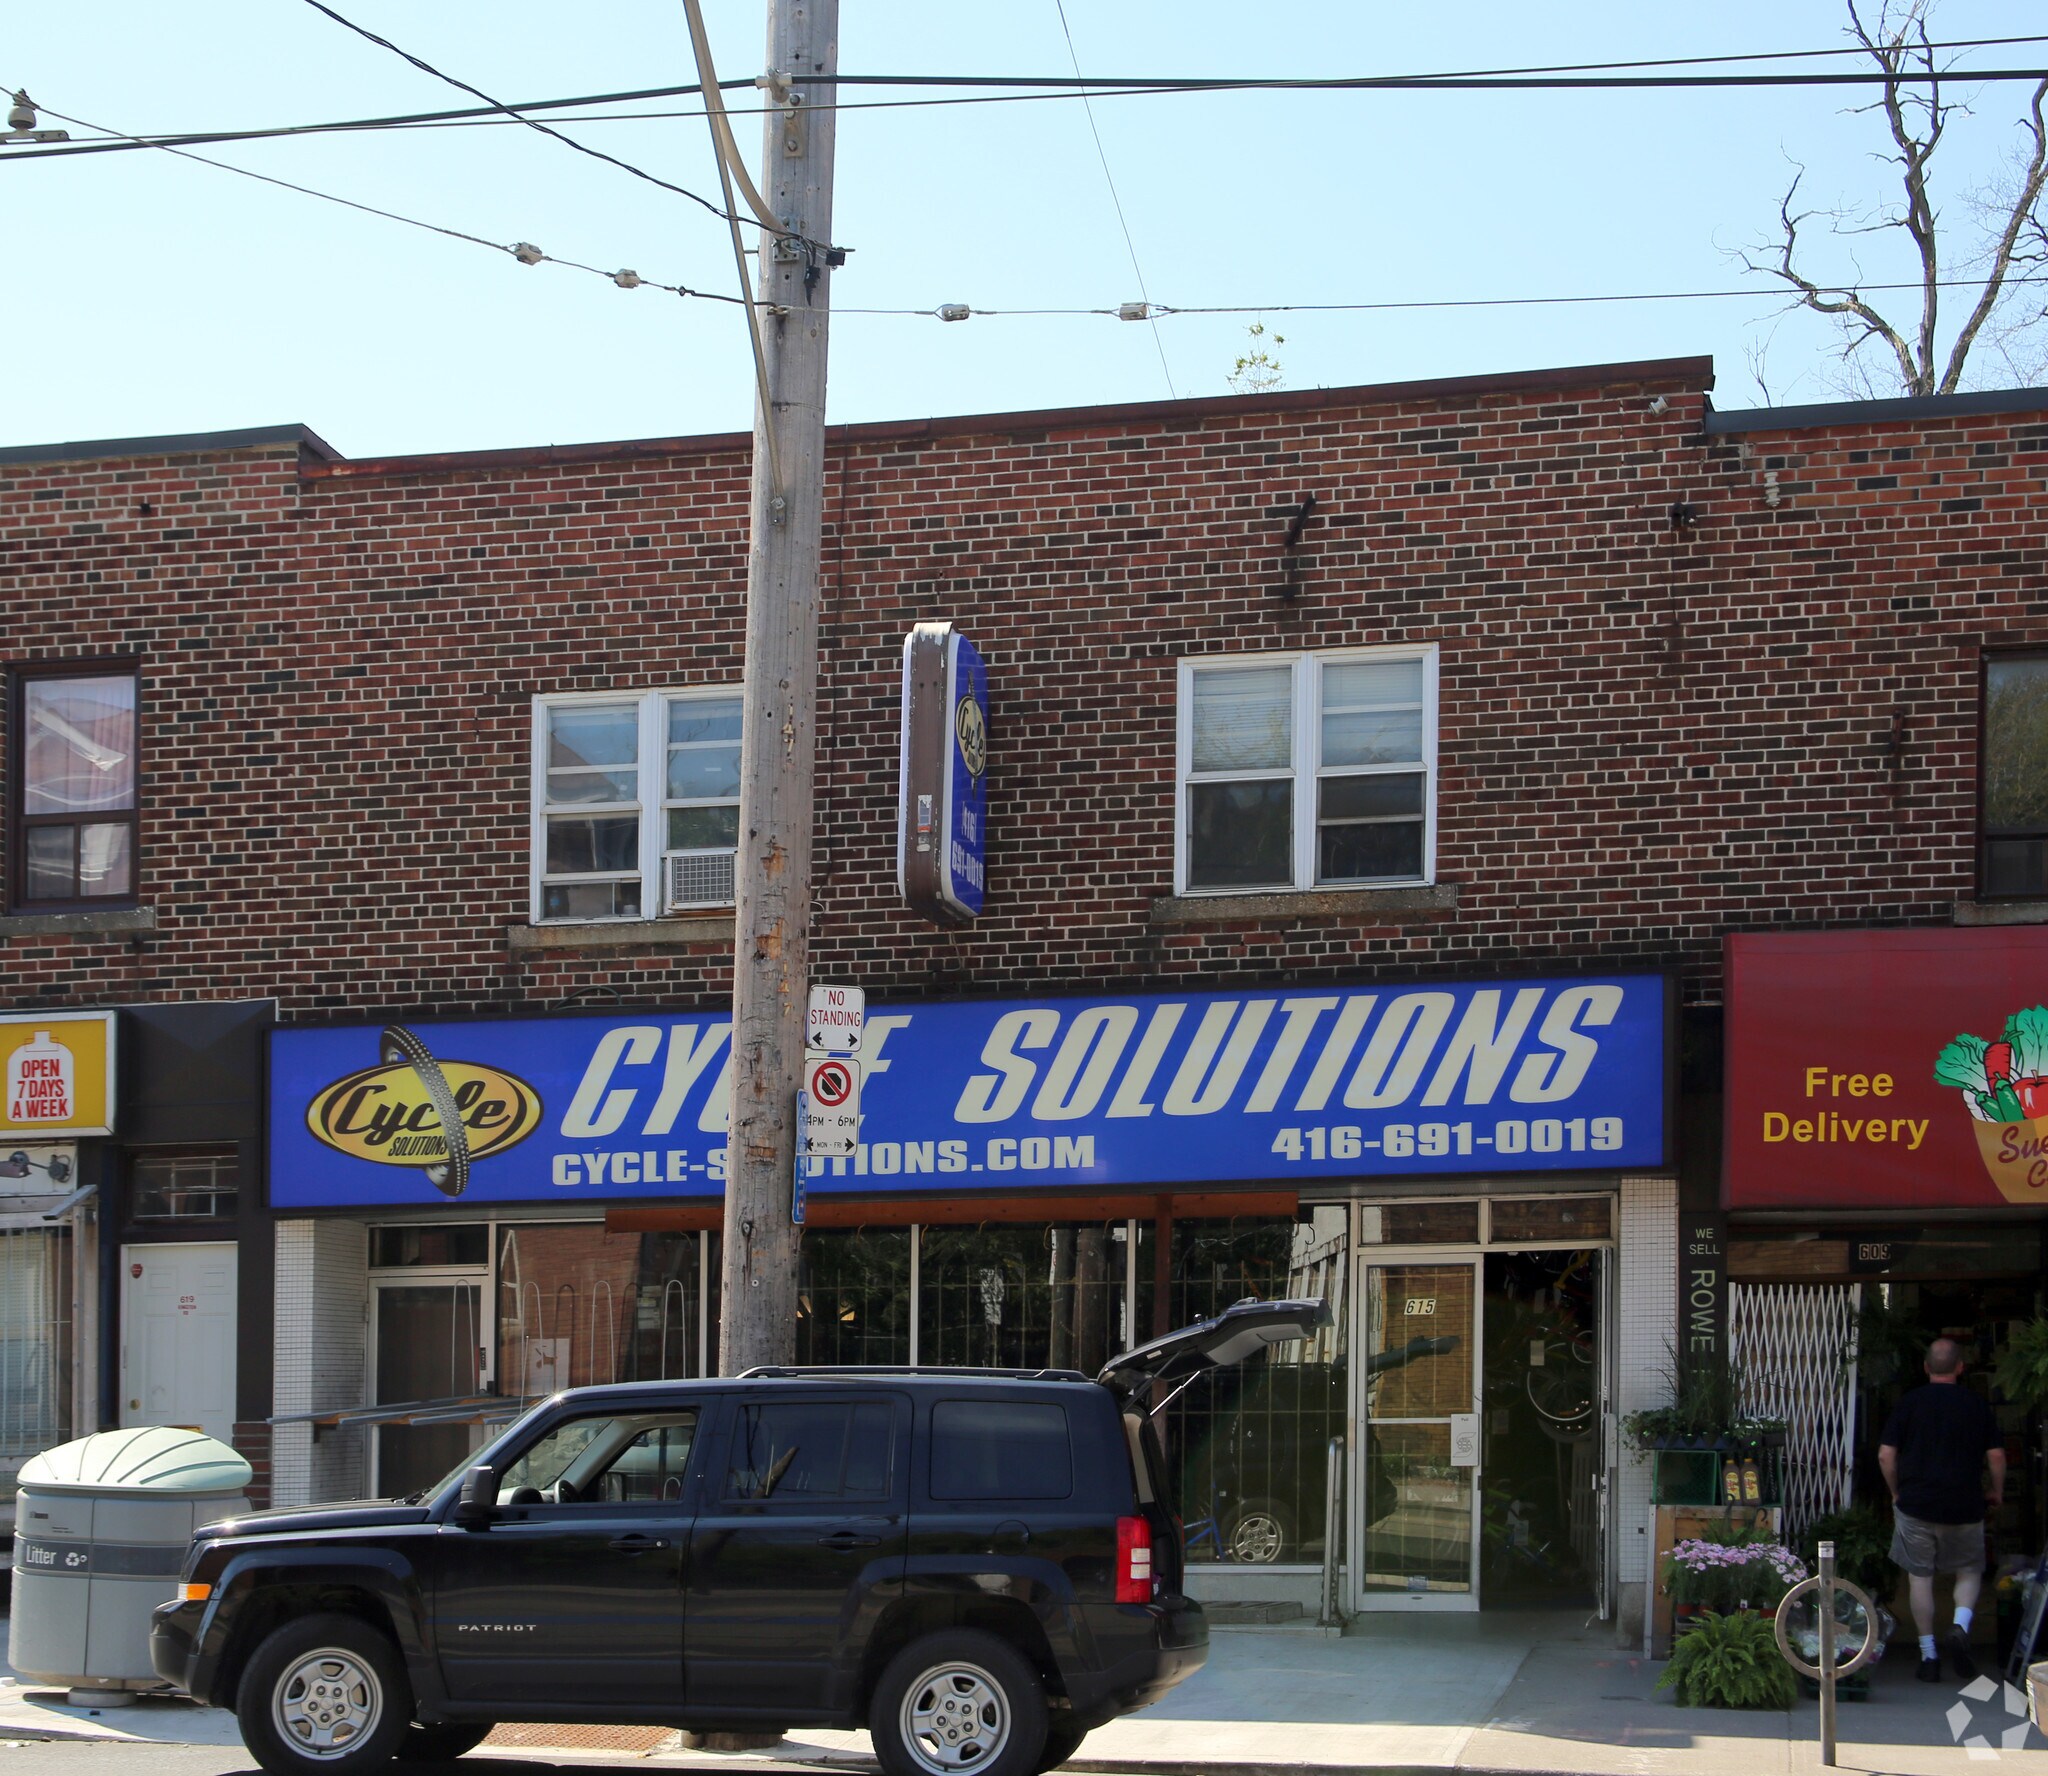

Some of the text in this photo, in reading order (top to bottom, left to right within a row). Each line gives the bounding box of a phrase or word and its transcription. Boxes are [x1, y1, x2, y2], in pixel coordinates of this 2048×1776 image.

[952, 840, 984, 892] 691-0019
[828, 990, 845, 1006] NO
[811, 1009, 861, 1027] STANDING
[22, 1058, 60, 1078] OPEN
[560, 1015, 913, 1138] CYE
[954, 985, 1624, 1125] SOLUTIONS
[17, 1079, 64, 1098] 7 DAYS
[1805, 1066, 1894, 1097] Free
[12, 1098, 68, 1118] A WEEK
[334, 1080, 511, 1145] Cycle
[807, 1114, 824, 1126] 4PM
[838, 1115, 856, 1127] 6PM
[1271, 1117, 1624, 1161] 416-691-0019
[1762, 1111, 1930, 1151] Delivery
[388, 1135, 448, 1157] SOLUTIONS
[816, 1141, 828, 1149] MON
[833, 1141, 842, 1149] FRI
[2027, 1159, 2048, 1188] C
[1695, 1227, 1714, 1239] WE
[1689, 1243, 1720, 1255] SELL
[1860, 1244, 1889, 1259] 609
[179, 1295, 195, 1303] 619
[1406, 1300, 1435, 1313] 615
[1690, 1269, 1715, 1353] ROWE
[26, 1545, 57, 1565] Litter
[458, 1624, 537, 1632] PATRIOT
